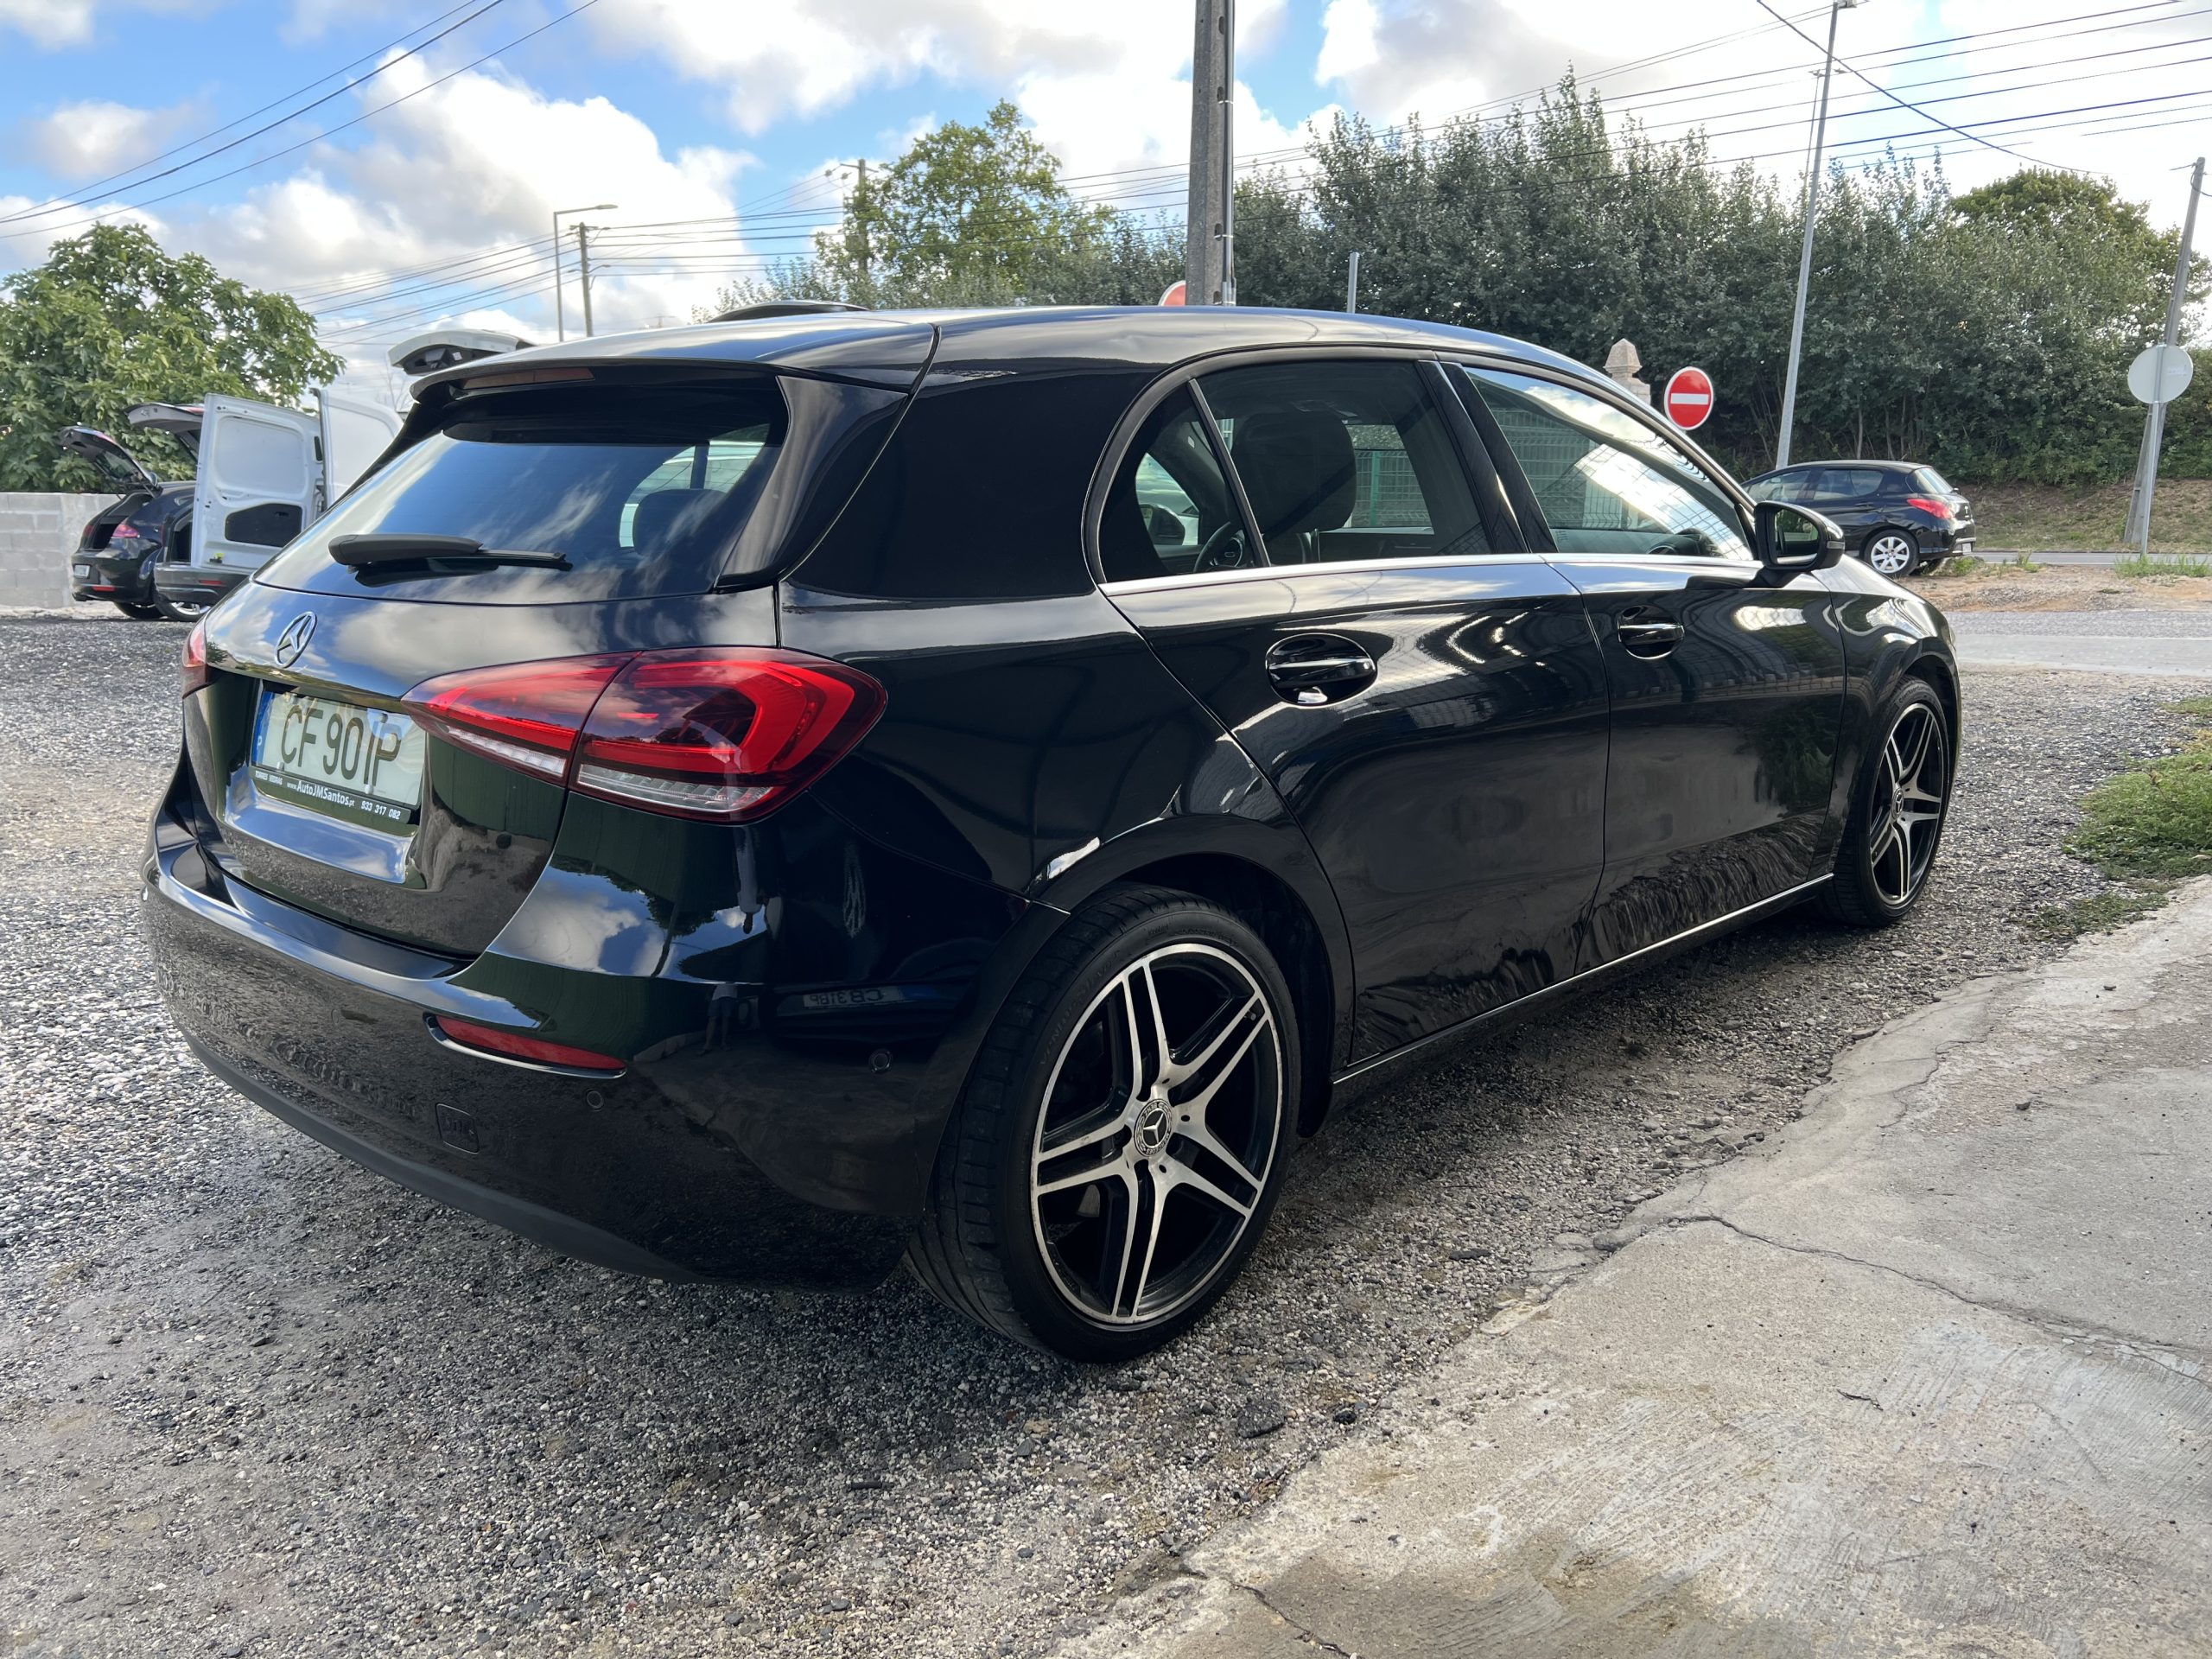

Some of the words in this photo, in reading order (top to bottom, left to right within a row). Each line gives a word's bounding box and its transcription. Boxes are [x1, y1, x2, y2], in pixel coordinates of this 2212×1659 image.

[360, 800, 373, 811] 933
[374, 804, 387, 816] 317
[388, 809, 401, 820] 082
